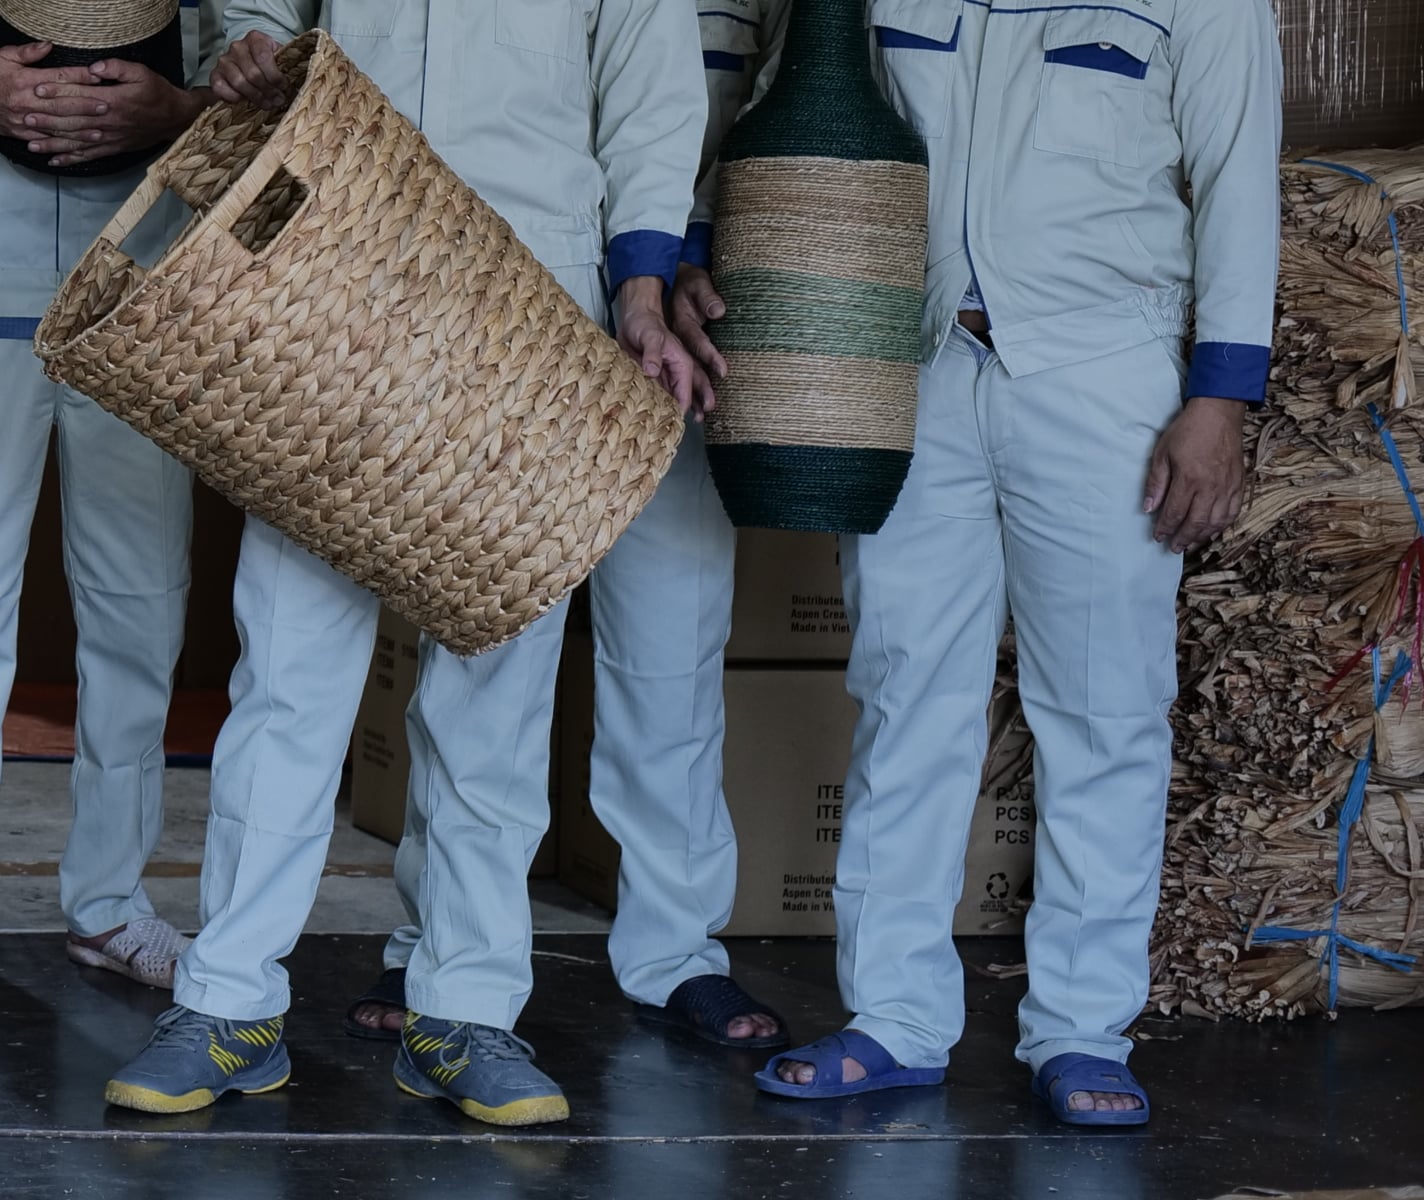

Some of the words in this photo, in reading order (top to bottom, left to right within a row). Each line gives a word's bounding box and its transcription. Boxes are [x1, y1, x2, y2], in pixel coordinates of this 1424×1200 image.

[791, 609, 820, 620] Aspen
[791, 622, 816, 632] Made
[820, 623, 828, 632] in
[996, 807, 1030, 821] PCS
[995, 830, 1030, 844] PCS
[782, 888, 811, 899] Aspen
[782, 902, 808, 911] Made
[811, 902, 820, 911] in
